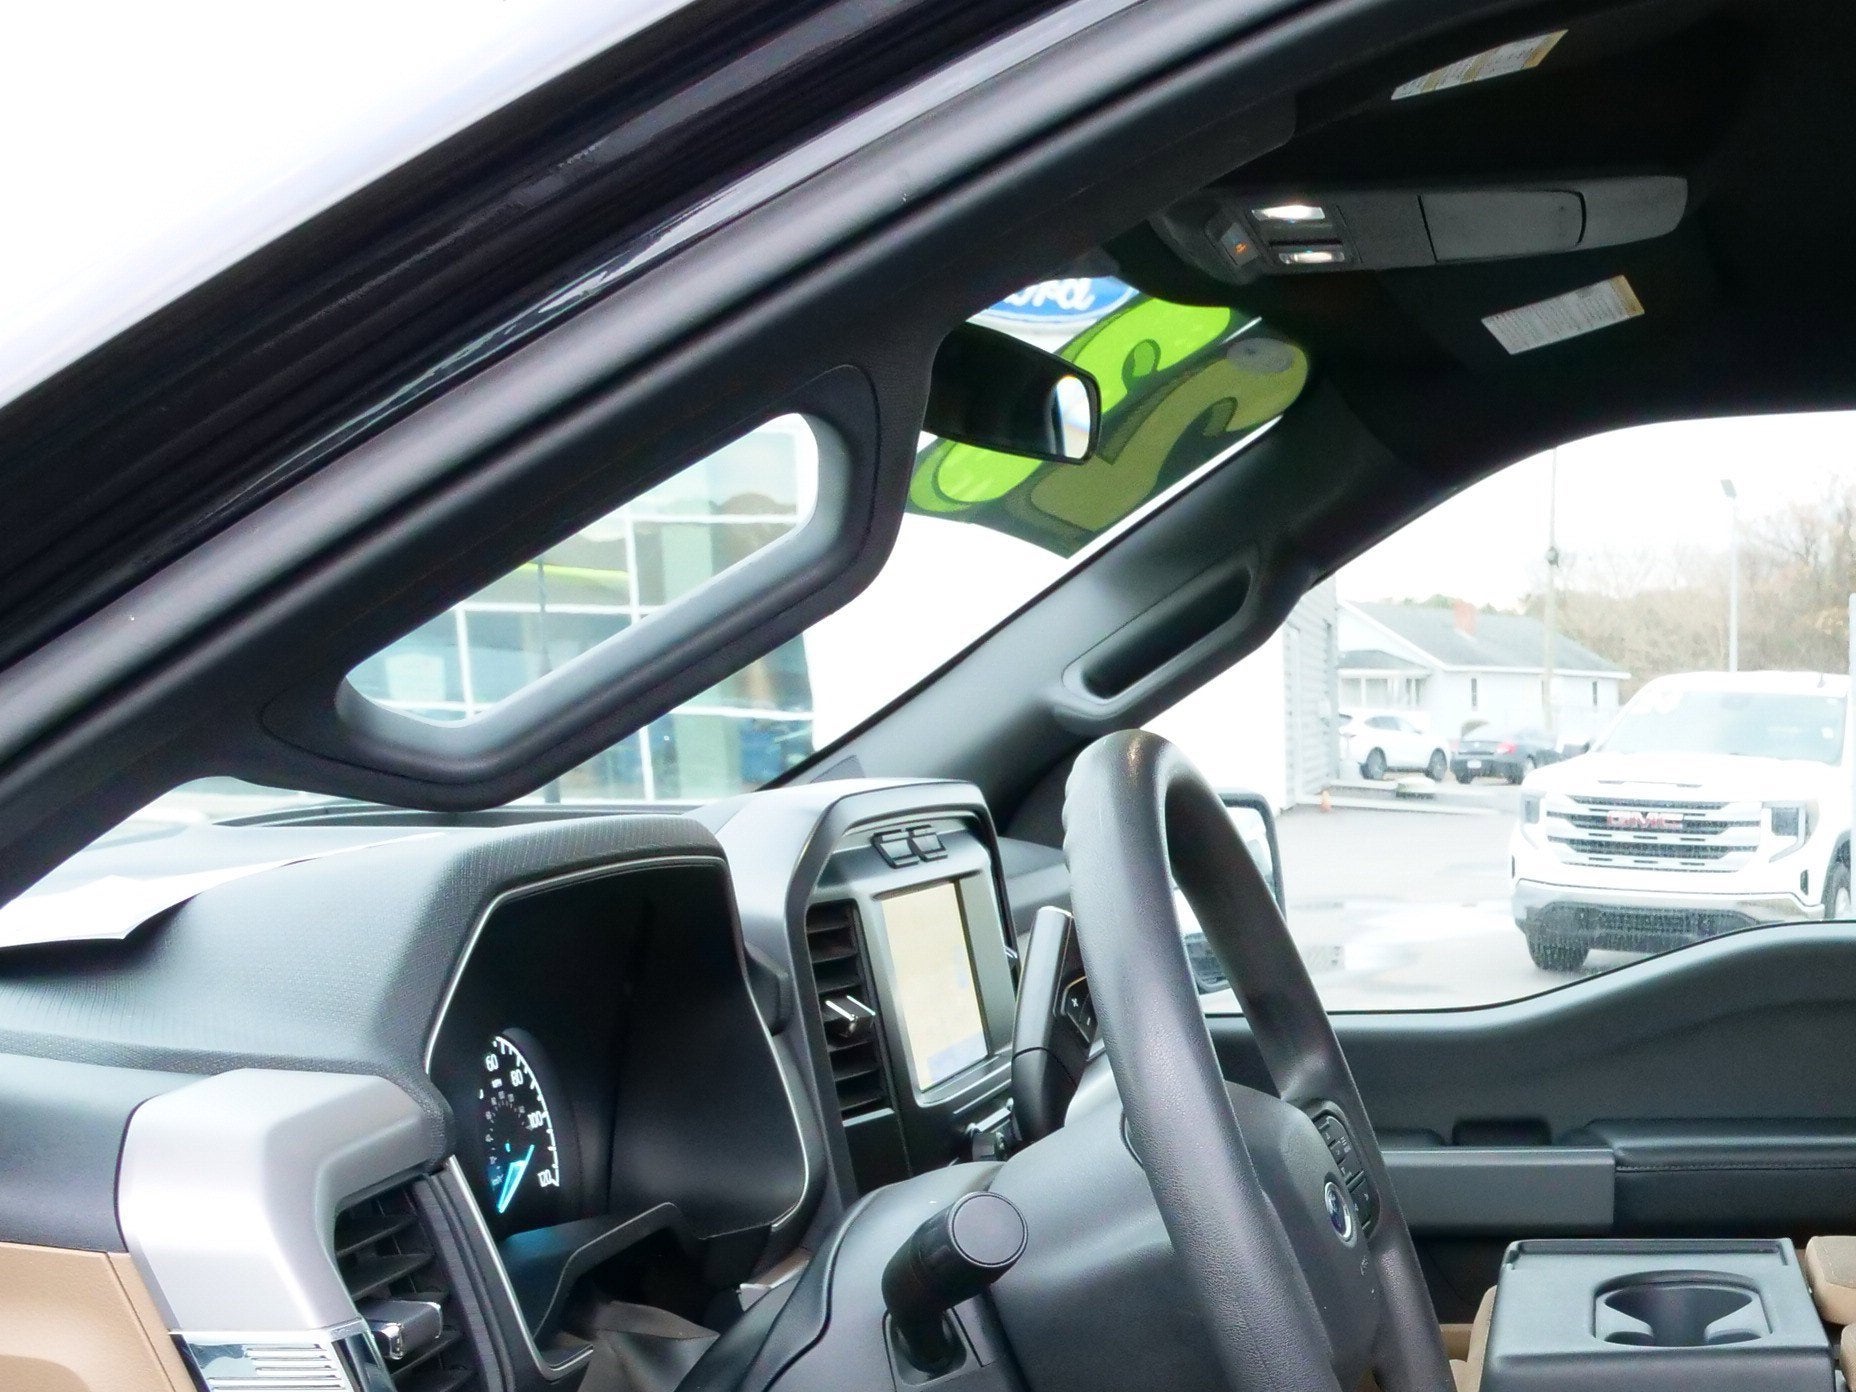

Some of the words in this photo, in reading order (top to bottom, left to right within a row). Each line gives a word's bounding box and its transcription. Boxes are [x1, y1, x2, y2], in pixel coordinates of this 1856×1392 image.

[1606, 811, 1684, 830] GMC
[485, 1053, 499, 1072] 60
[510, 1069, 524, 1087] 80
[527, 1111, 544, 1129] 100
[537, 1169, 553, 1187] 120
